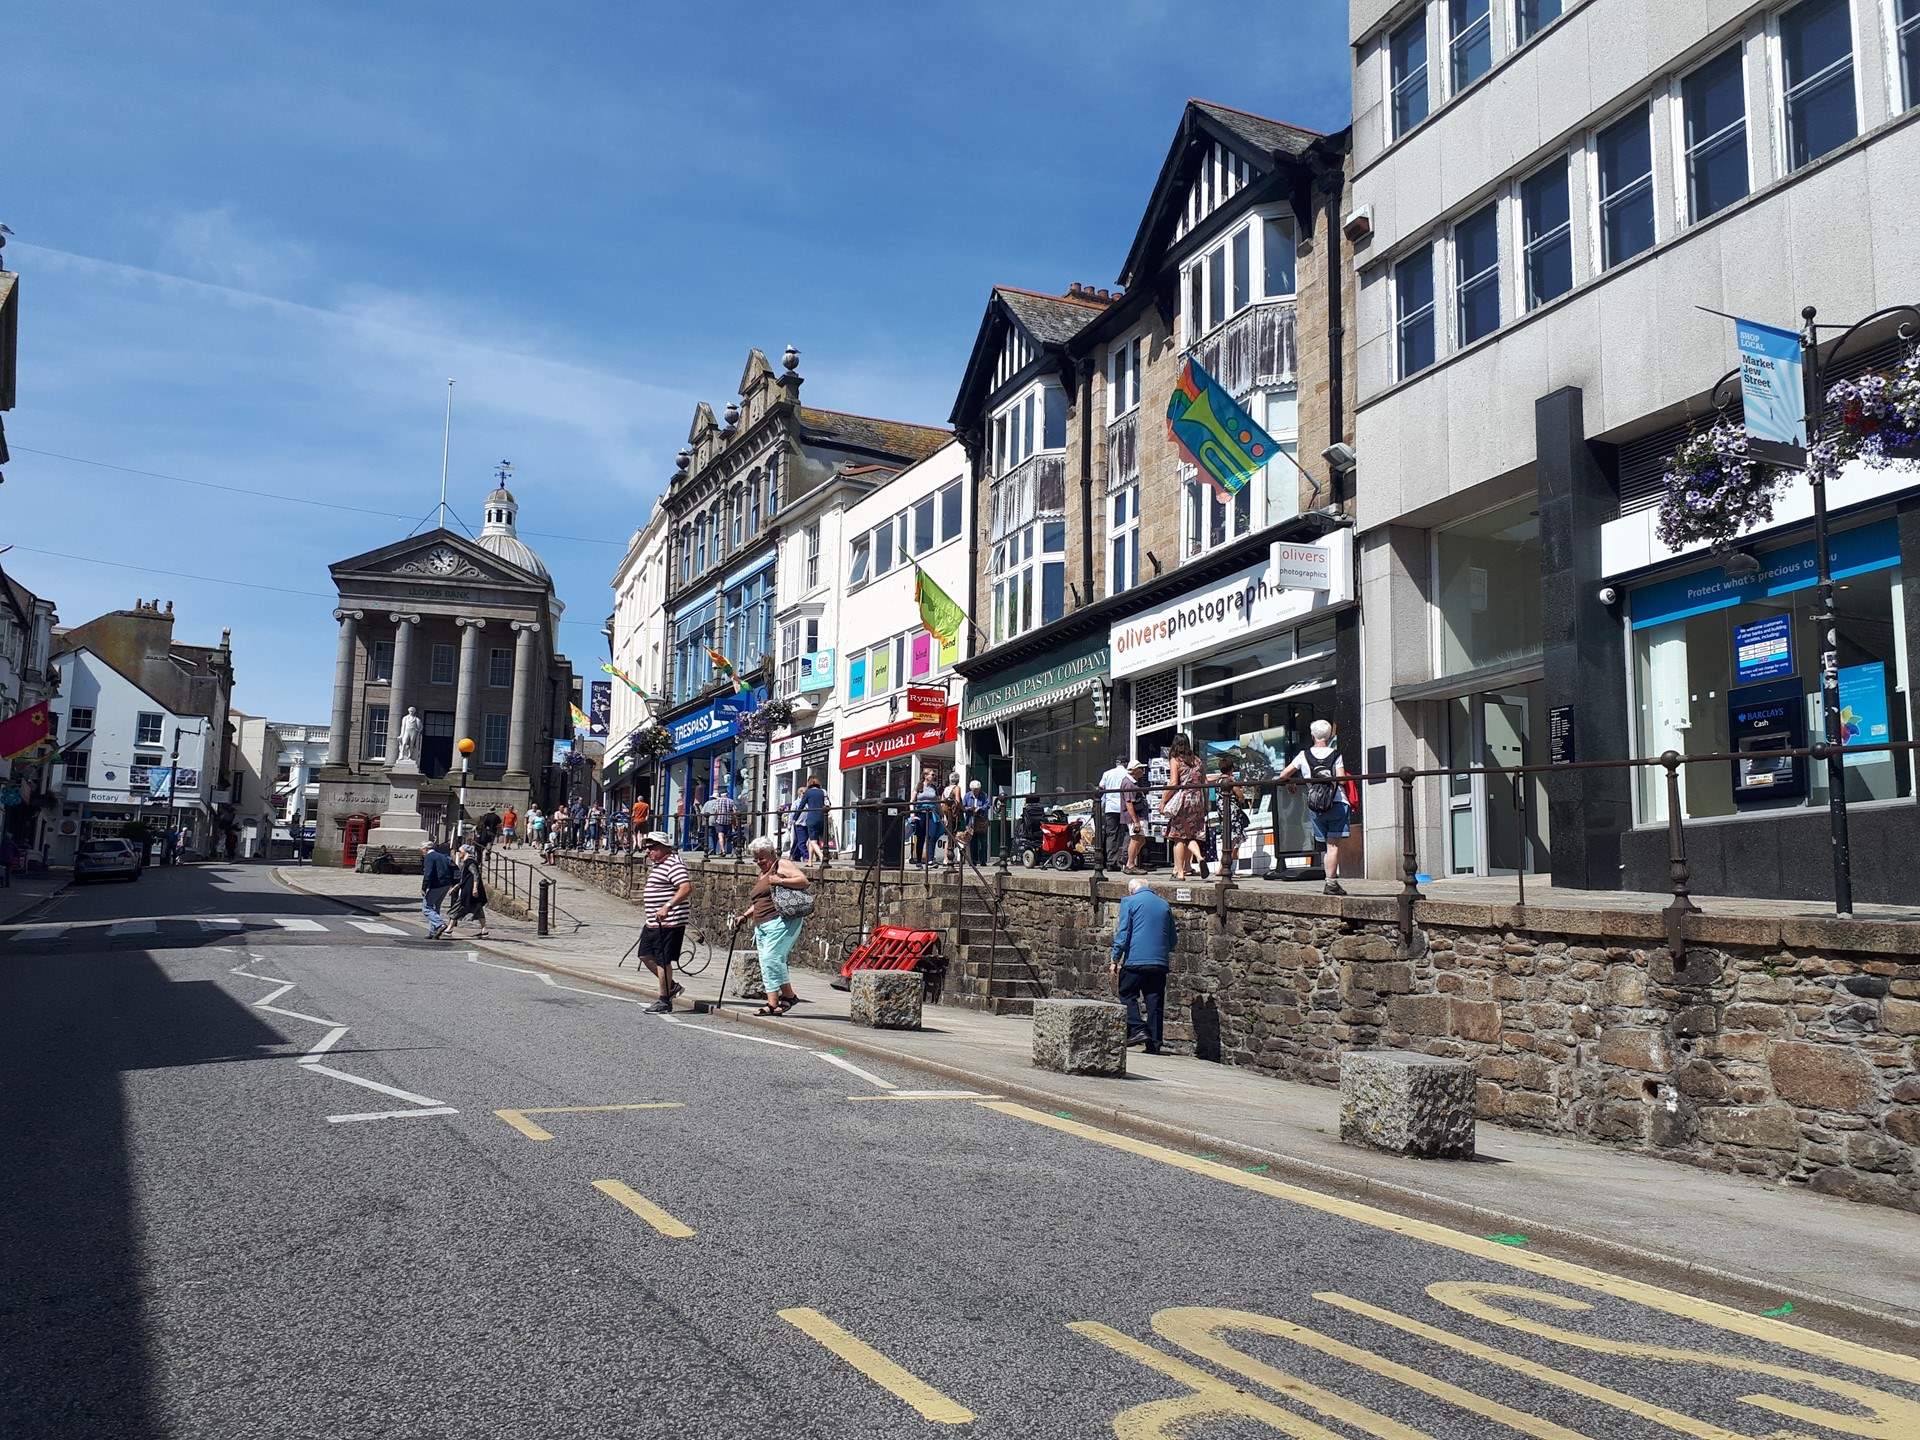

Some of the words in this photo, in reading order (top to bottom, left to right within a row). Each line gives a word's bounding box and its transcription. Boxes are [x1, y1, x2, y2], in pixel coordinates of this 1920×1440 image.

[1740, 331, 1760, 341] SHOP
[1741, 339, 1765, 352] LOCAL
[1742, 354, 1775, 370] Market
[1744, 364, 1762, 376] Jew
[1744, 374, 1772, 389] Street
[1282, 548, 1325, 563] olivers
[1280, 568, 1328, 580] photographics
[1687, 582, 1721, 599] Protect
[1723, 574, 1756, 591] what's
[1758, 562, 1801, 584] precious
[1803, 558, 1814, 568] to
[942, 638, 956, 651] send
[876, 664, 888, 678] print
[1004, 680, 1022, 701] BAY
[1023, 670, 1056, 694] PASTY
[1057, 650, 1110, 680] COMPANY
[910, 694, 944, 708] Ryman
[1747, 707, 1784, 720] BARCLAYS
[674, 715, 709, 744] TRESPASS
[1754, 720, 1769, 728] Cash
[864, 732, 916, 758] Ryman
[91, 794, 119, 803] Rotary
